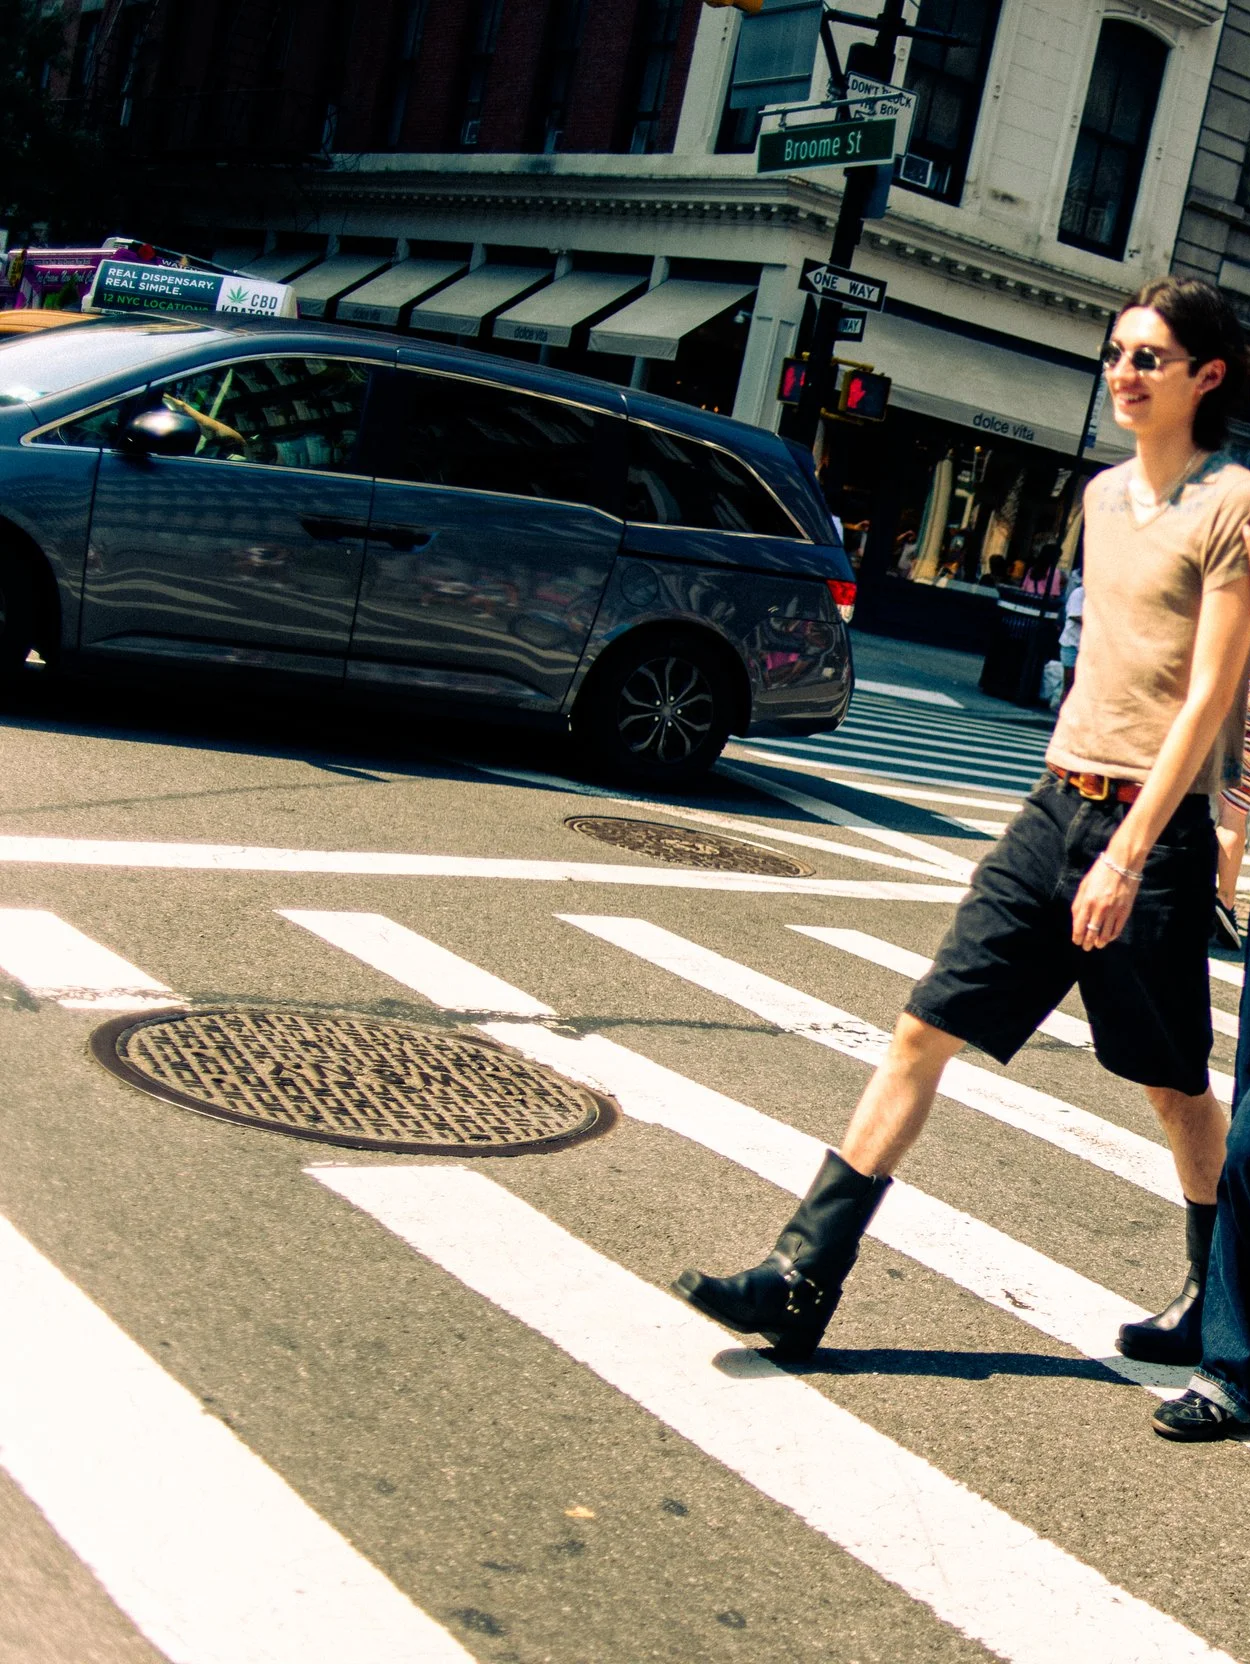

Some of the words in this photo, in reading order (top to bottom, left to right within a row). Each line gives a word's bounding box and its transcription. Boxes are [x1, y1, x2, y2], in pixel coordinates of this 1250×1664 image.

[851, 78, 879, 95] DON'T
[882, 86, 912, 108] BOCK
[784, 138, 841, 161] Broome
[846, 129, 862, 154] St
[105, 277, 135, 289] REAL
[138, 282, 182, 296] SIMPLE.
[108, 267, 138, 280] REAL
[141, 272, 215, 290] DISPENSARY.
[814, 271, 840, 290] ONE
[848, 281, 875, 300] WAY
[103, 292, 114, 303] 12
[117, 294, 140, 306] NYC
[251, 294, 278, 310] CBD
[514, 326, 534, 340] dolce
[973, 412, 1009, 434] dolce
[1012, 424, 1035, 441] vita
